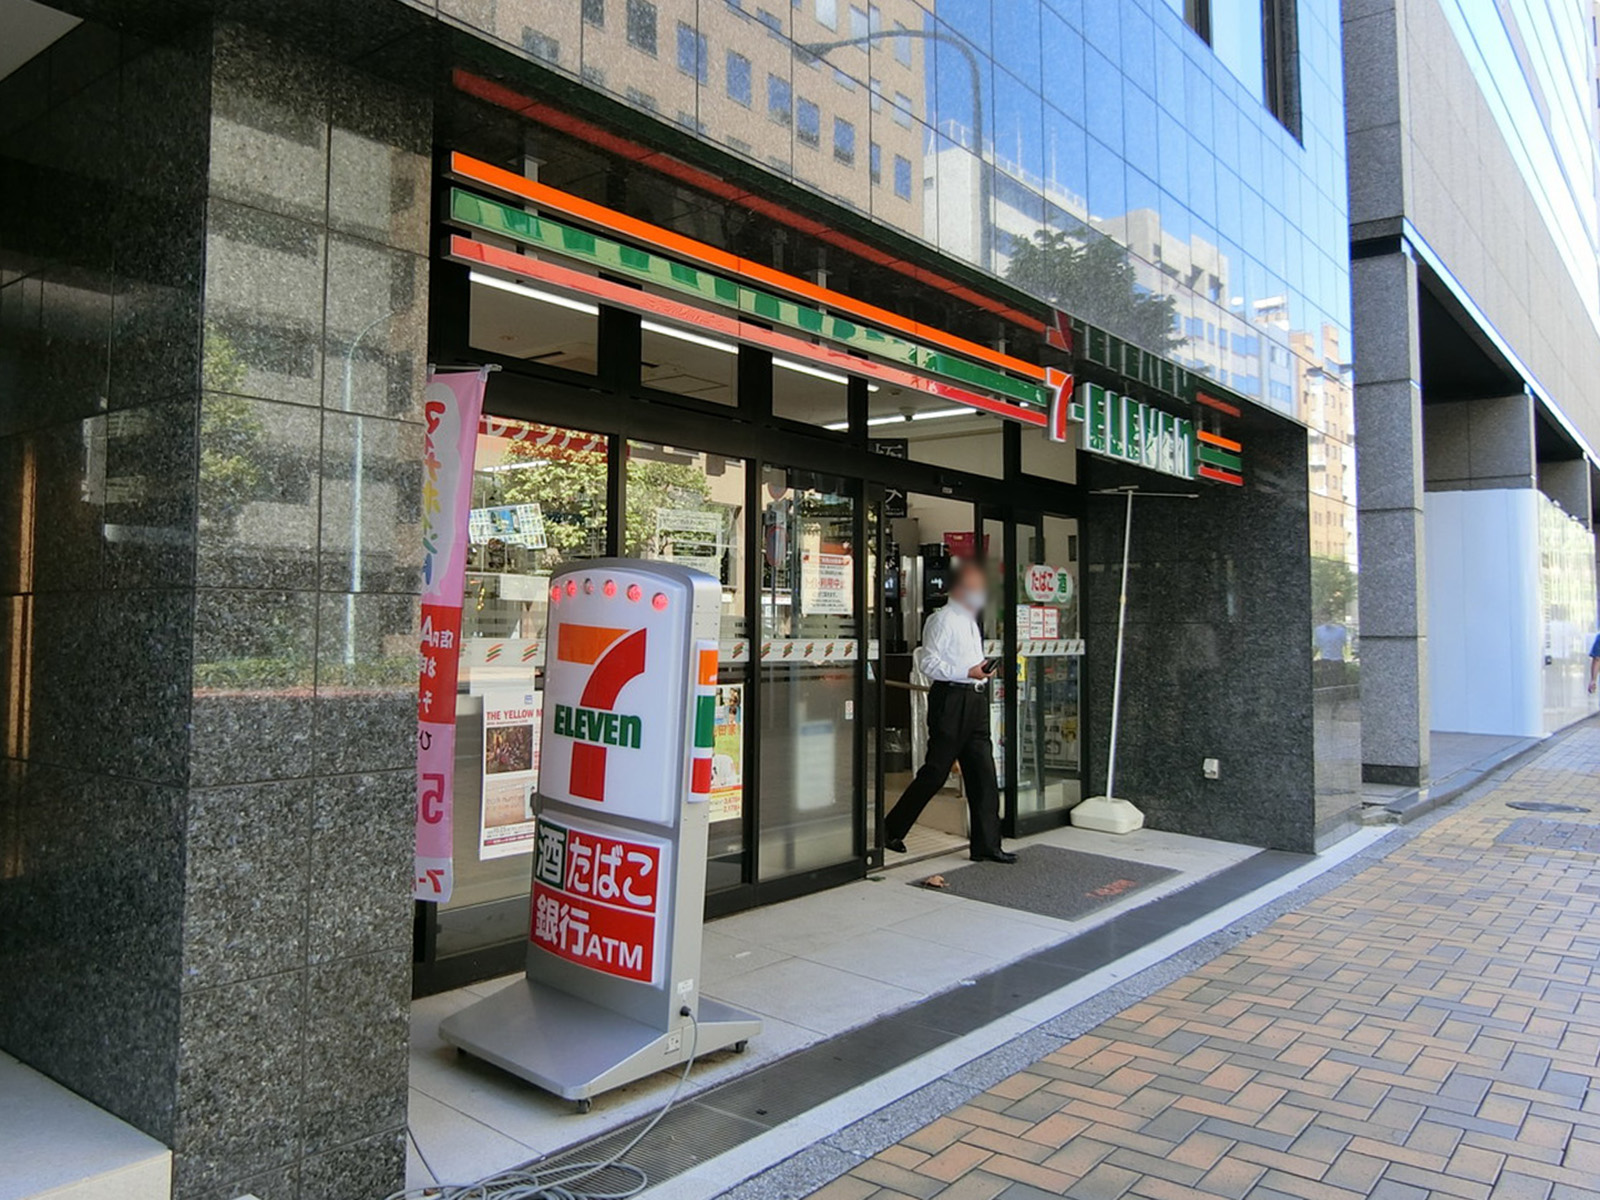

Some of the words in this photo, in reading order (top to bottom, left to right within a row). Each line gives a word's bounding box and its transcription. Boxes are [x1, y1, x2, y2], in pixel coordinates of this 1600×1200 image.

[1031, 571, 1054, 592] たばこ
[486, 711, 501, 720] THE
[503, 709, 534, 720] YELLOW
[557, 622, 647, 803] 7
[536, 824, 565, 884] 酒
[567, 837, 654, 906] たばこ
[535, 893, 643, 971] 銀行ATM
